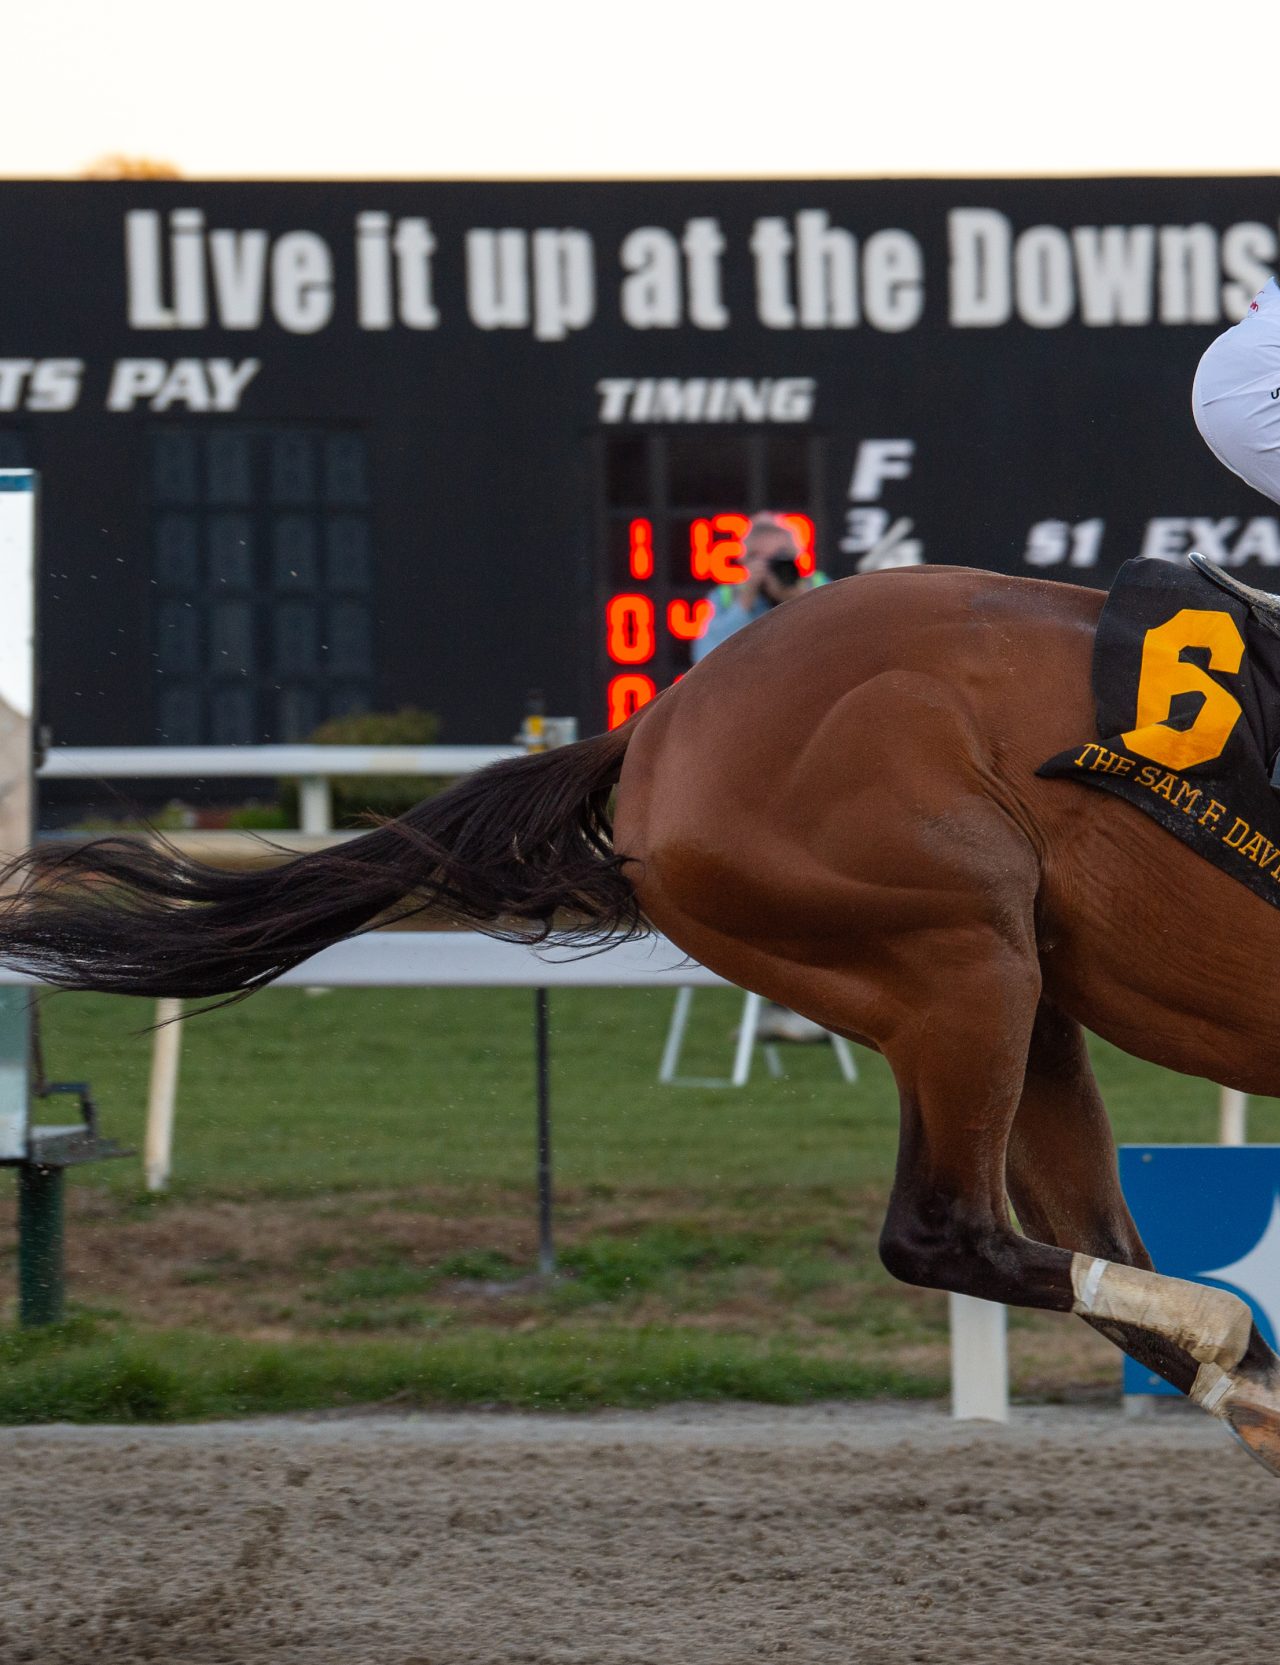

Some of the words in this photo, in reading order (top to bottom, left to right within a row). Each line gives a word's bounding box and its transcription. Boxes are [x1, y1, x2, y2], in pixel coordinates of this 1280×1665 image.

[126, 210, 334, 332] Live
[356, 212, 440, 330] it
[465, 229, 595, 340] up
[620, 217, 730, 330] at
[750, 210, 925, 332] the
[107, 357, 261, 412] PAY
[598, 377, 815, 423] TIMING
[849, 438, 917, 501] F
[1121, 608, 1247, 770] 6
[1074, 743, 1136, 776] THE
[1134, 765, 1203, 814] SAM
[1197, 799, 1227, 834] F.
